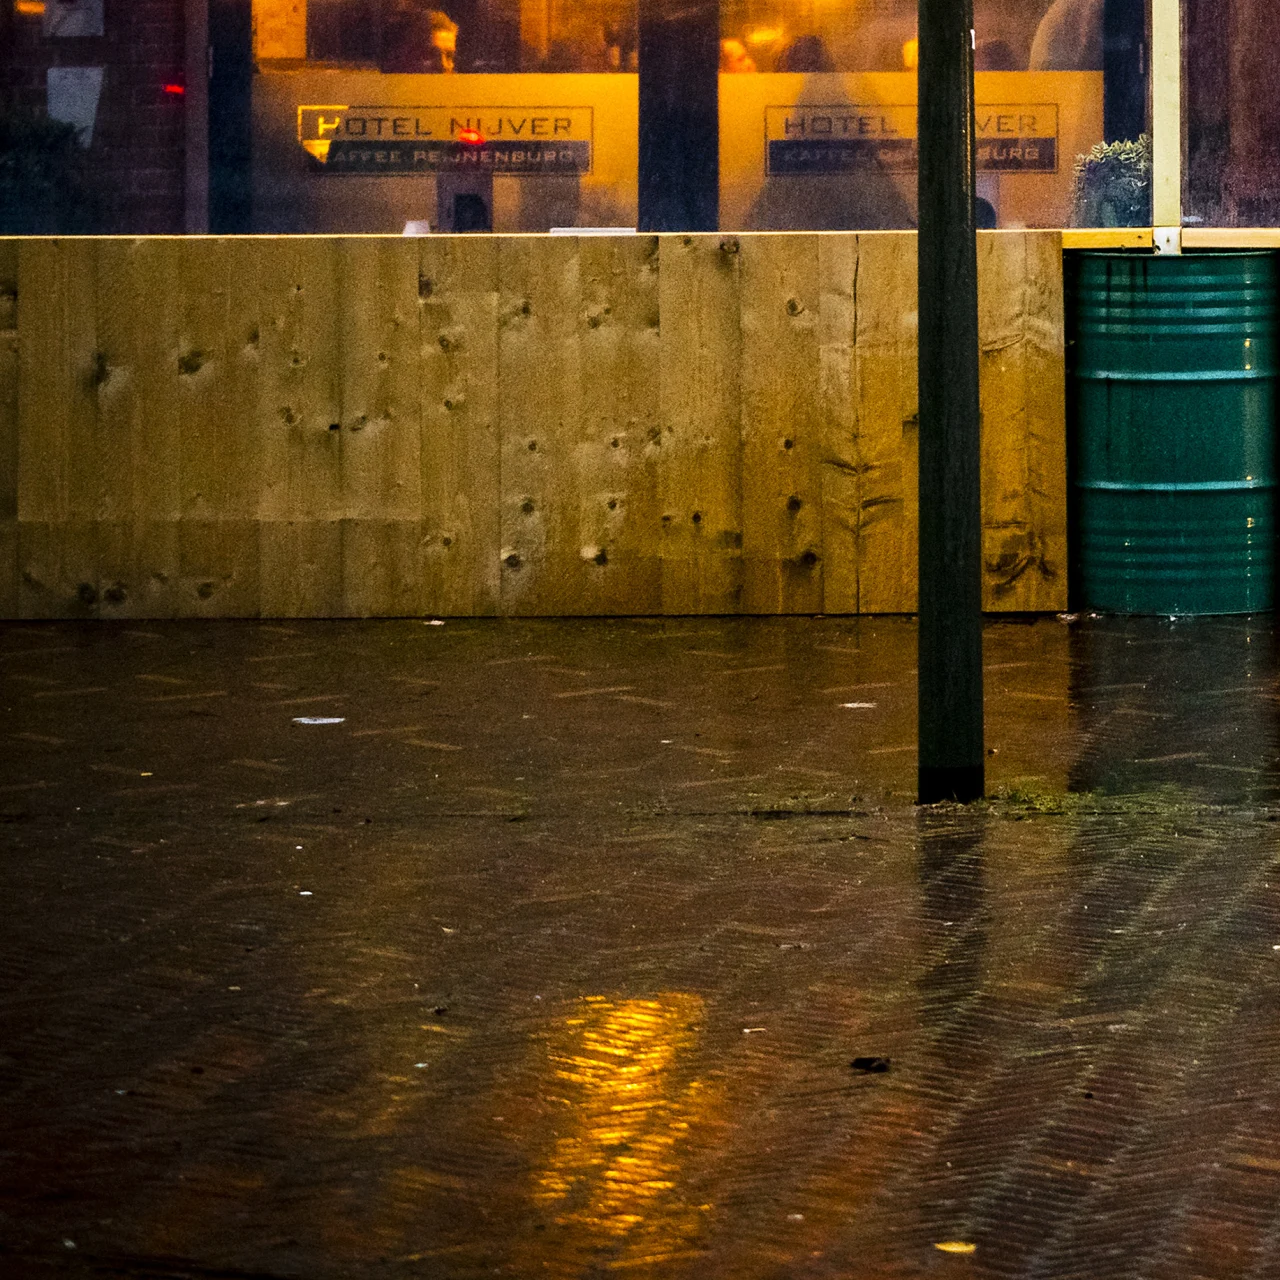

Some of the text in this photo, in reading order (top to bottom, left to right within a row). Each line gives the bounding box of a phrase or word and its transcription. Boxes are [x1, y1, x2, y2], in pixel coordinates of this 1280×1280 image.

[317, 116, 573, 136] HOTEL NIJVER
[785, 114, 898, 134] HOTEL
